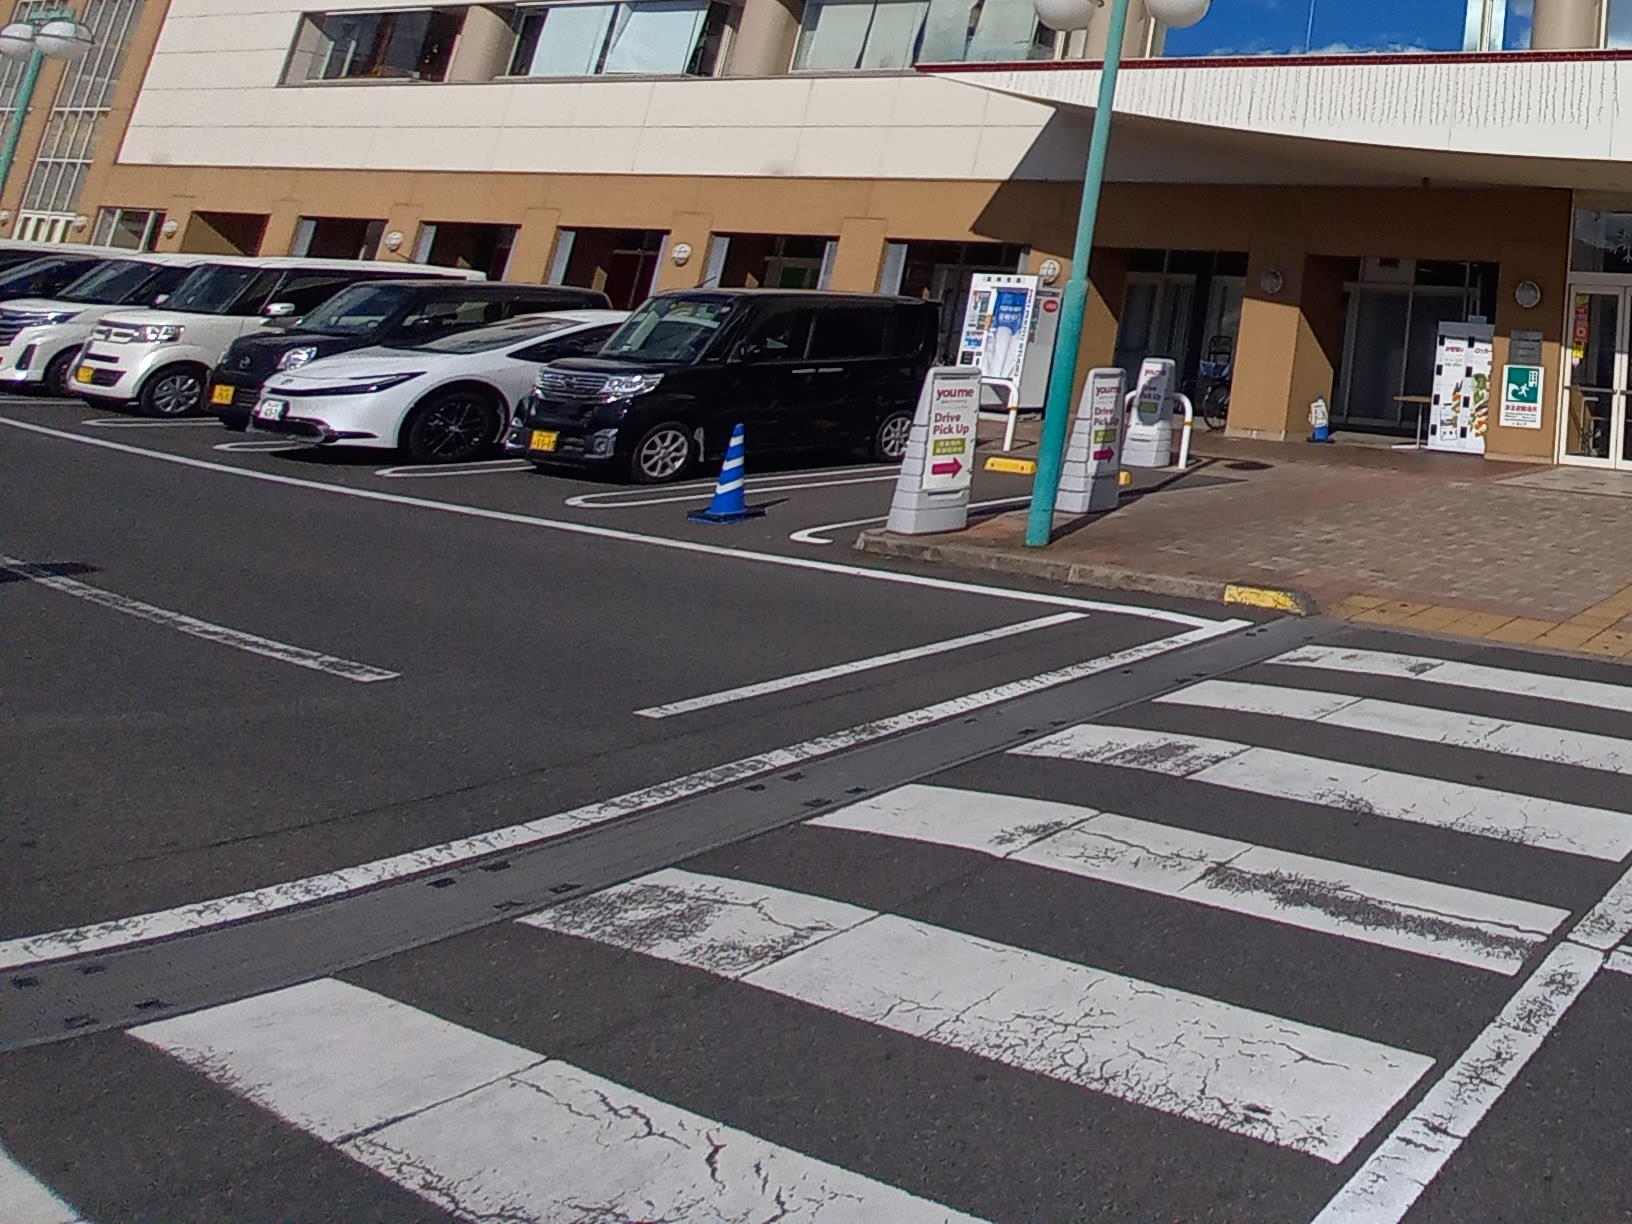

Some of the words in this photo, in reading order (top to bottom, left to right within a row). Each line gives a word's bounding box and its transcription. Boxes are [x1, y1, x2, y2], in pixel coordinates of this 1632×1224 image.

[934, 412, 962, 423] Drive
[933, 424, 955, 435] Pick
[956, 424, 970, 436] Up
